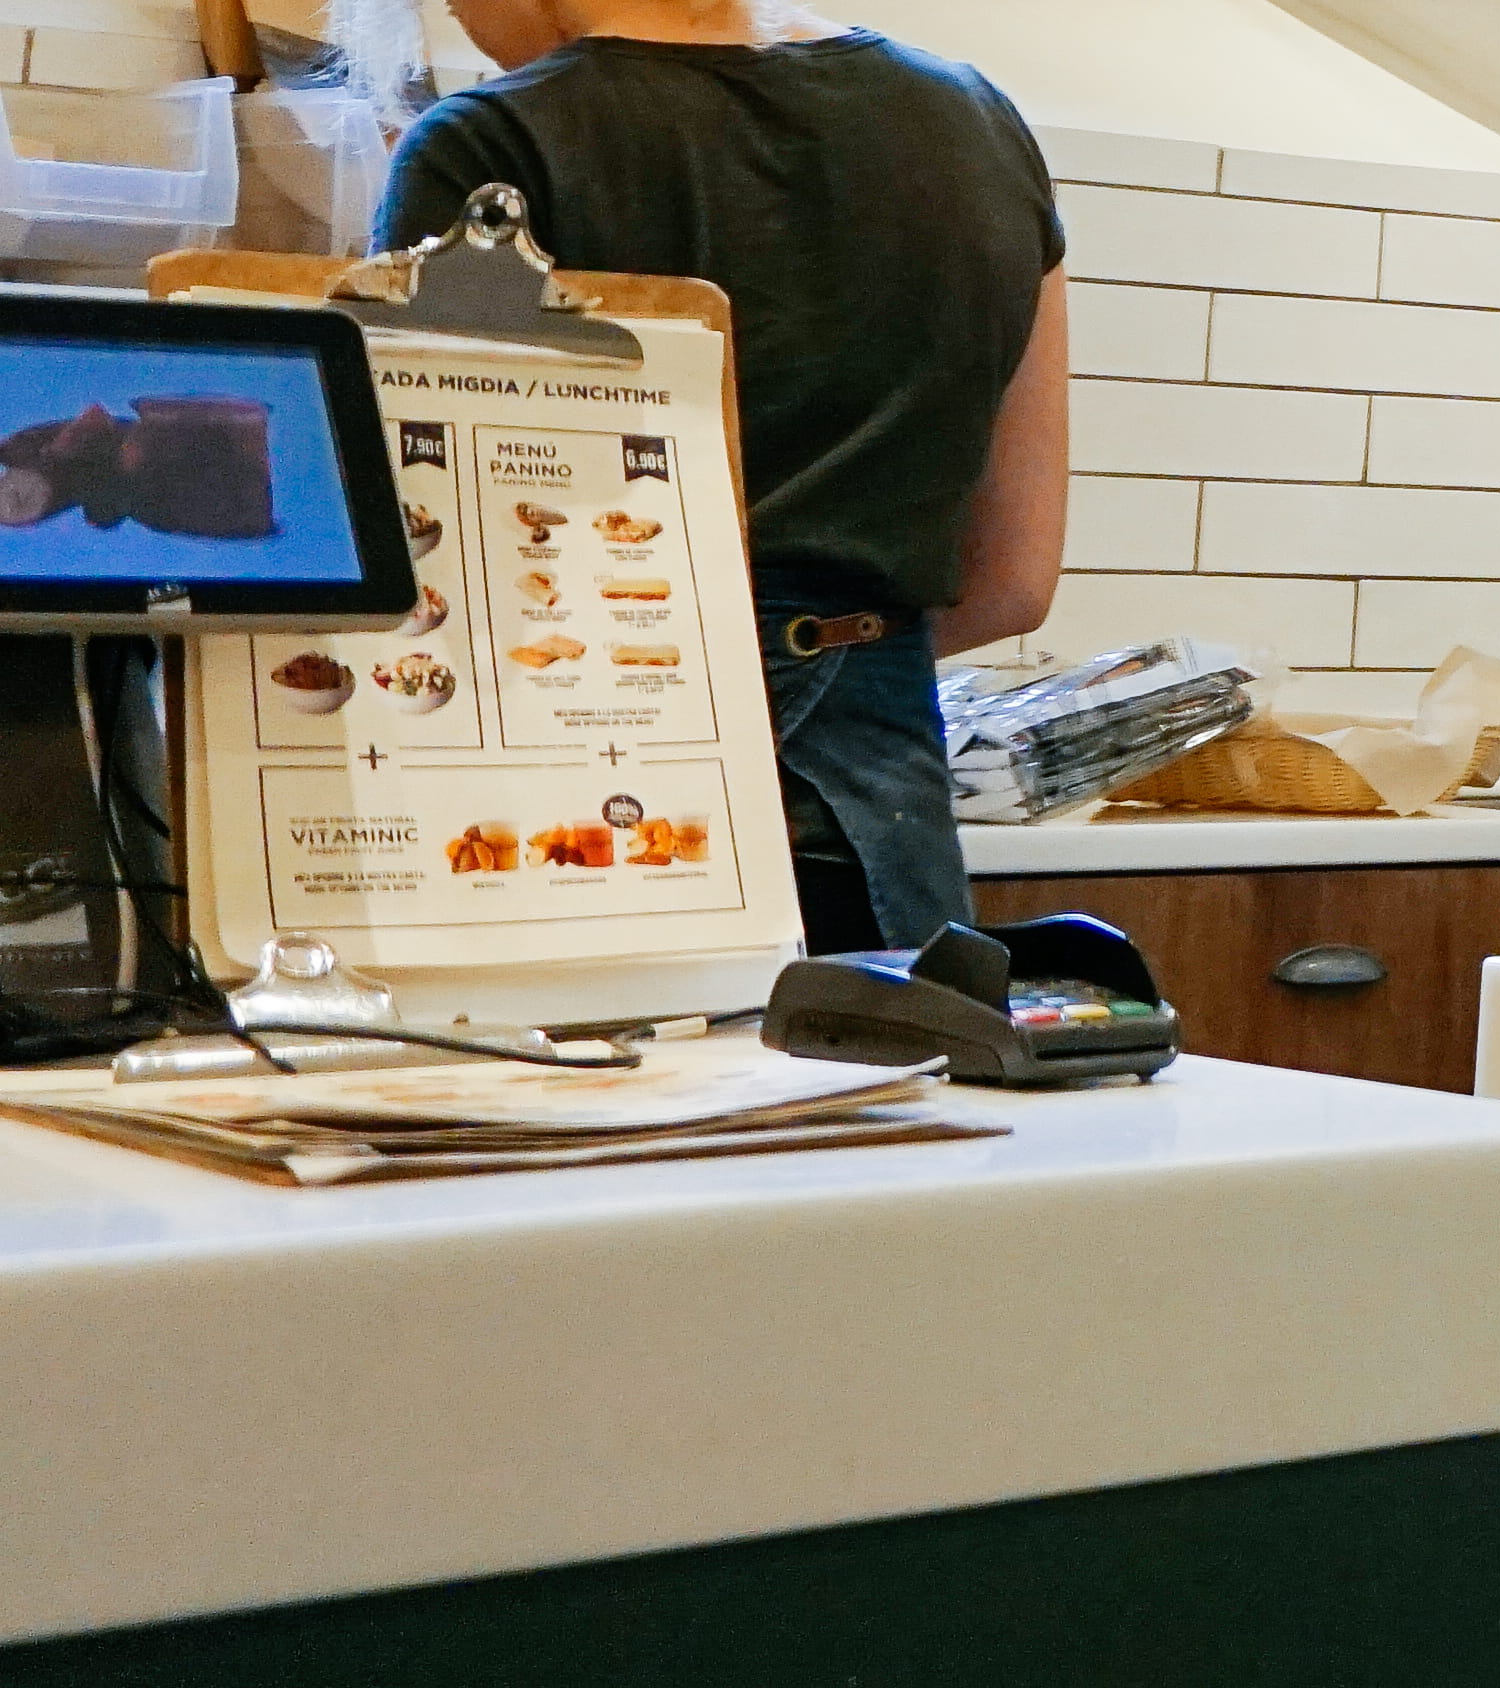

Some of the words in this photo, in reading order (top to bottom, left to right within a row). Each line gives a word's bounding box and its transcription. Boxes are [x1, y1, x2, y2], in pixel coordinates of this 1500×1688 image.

[374, 369, 430, 389] ADA
[437, 374, 520, 396] MIGDIA
[543, 379, 672, 406] LUNCHTIME
[489, 459, 573, 478] PANINO
[291, 827, 419, 846] VITAMINIC
